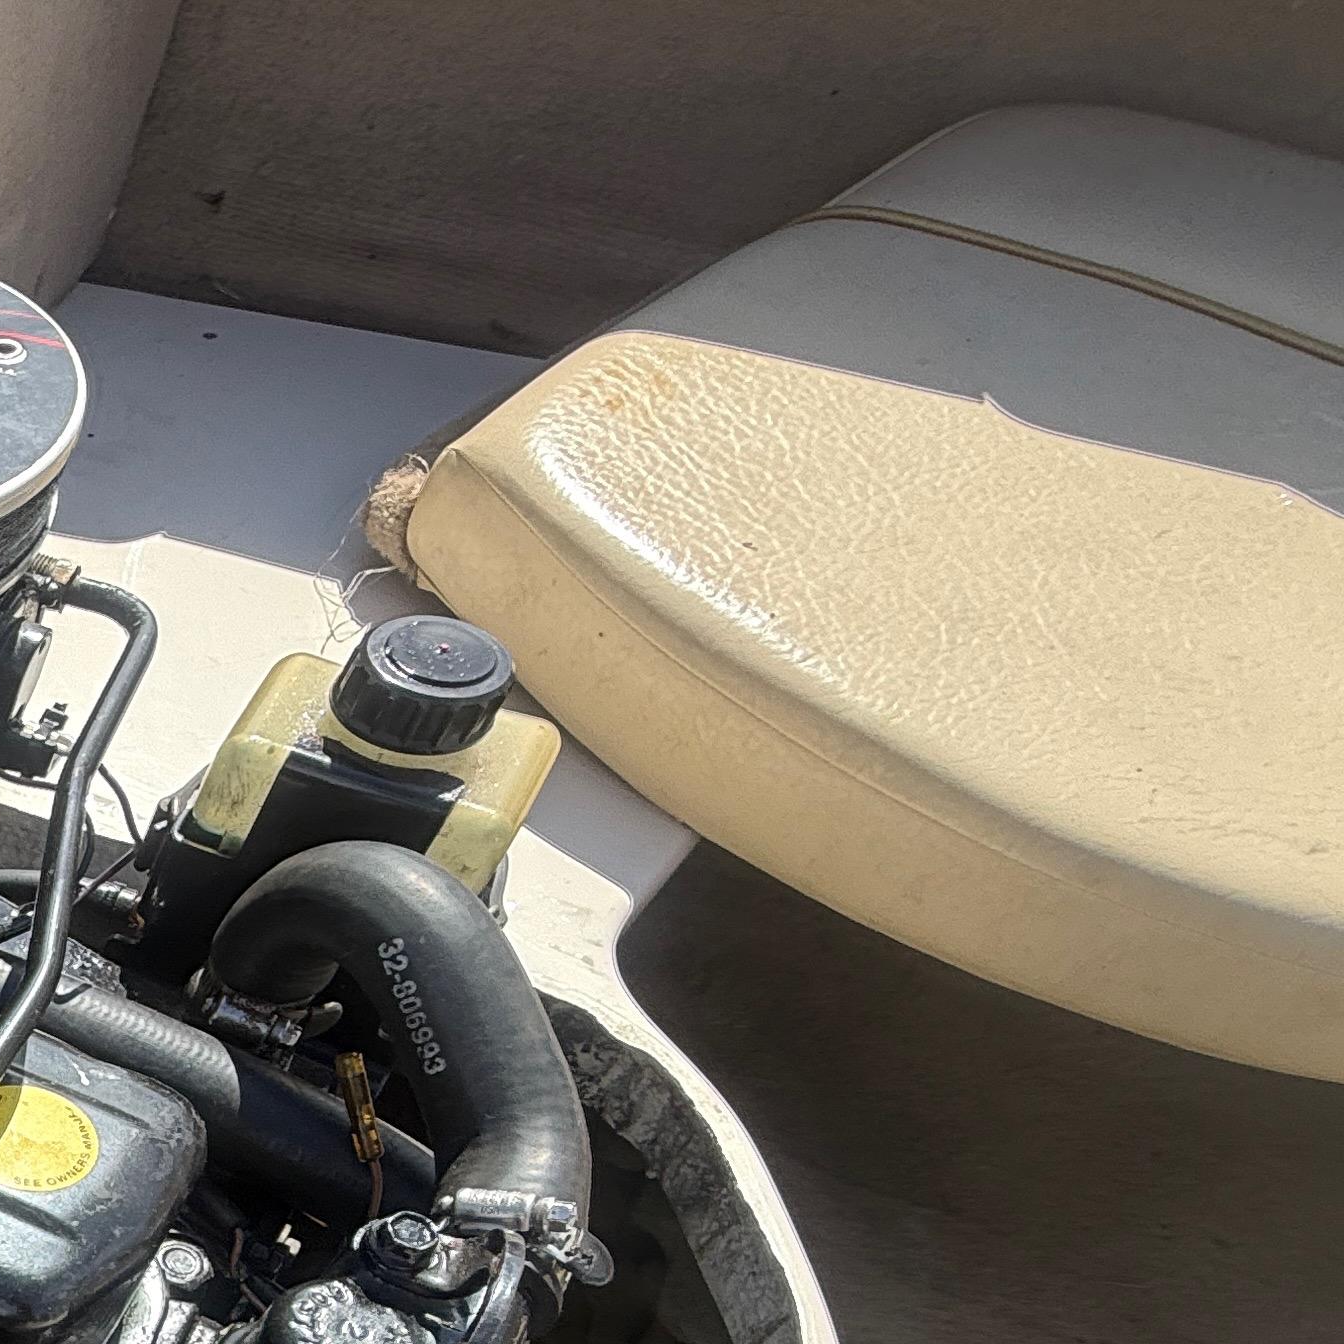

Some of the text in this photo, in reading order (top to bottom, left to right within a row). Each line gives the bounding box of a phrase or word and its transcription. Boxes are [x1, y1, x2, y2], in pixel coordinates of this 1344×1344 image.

[377, 937, 447, 1076] 32-806993
[14, 1176, 41, 1188] SEE
[46, 1152, 91, 1187] OWNERS
